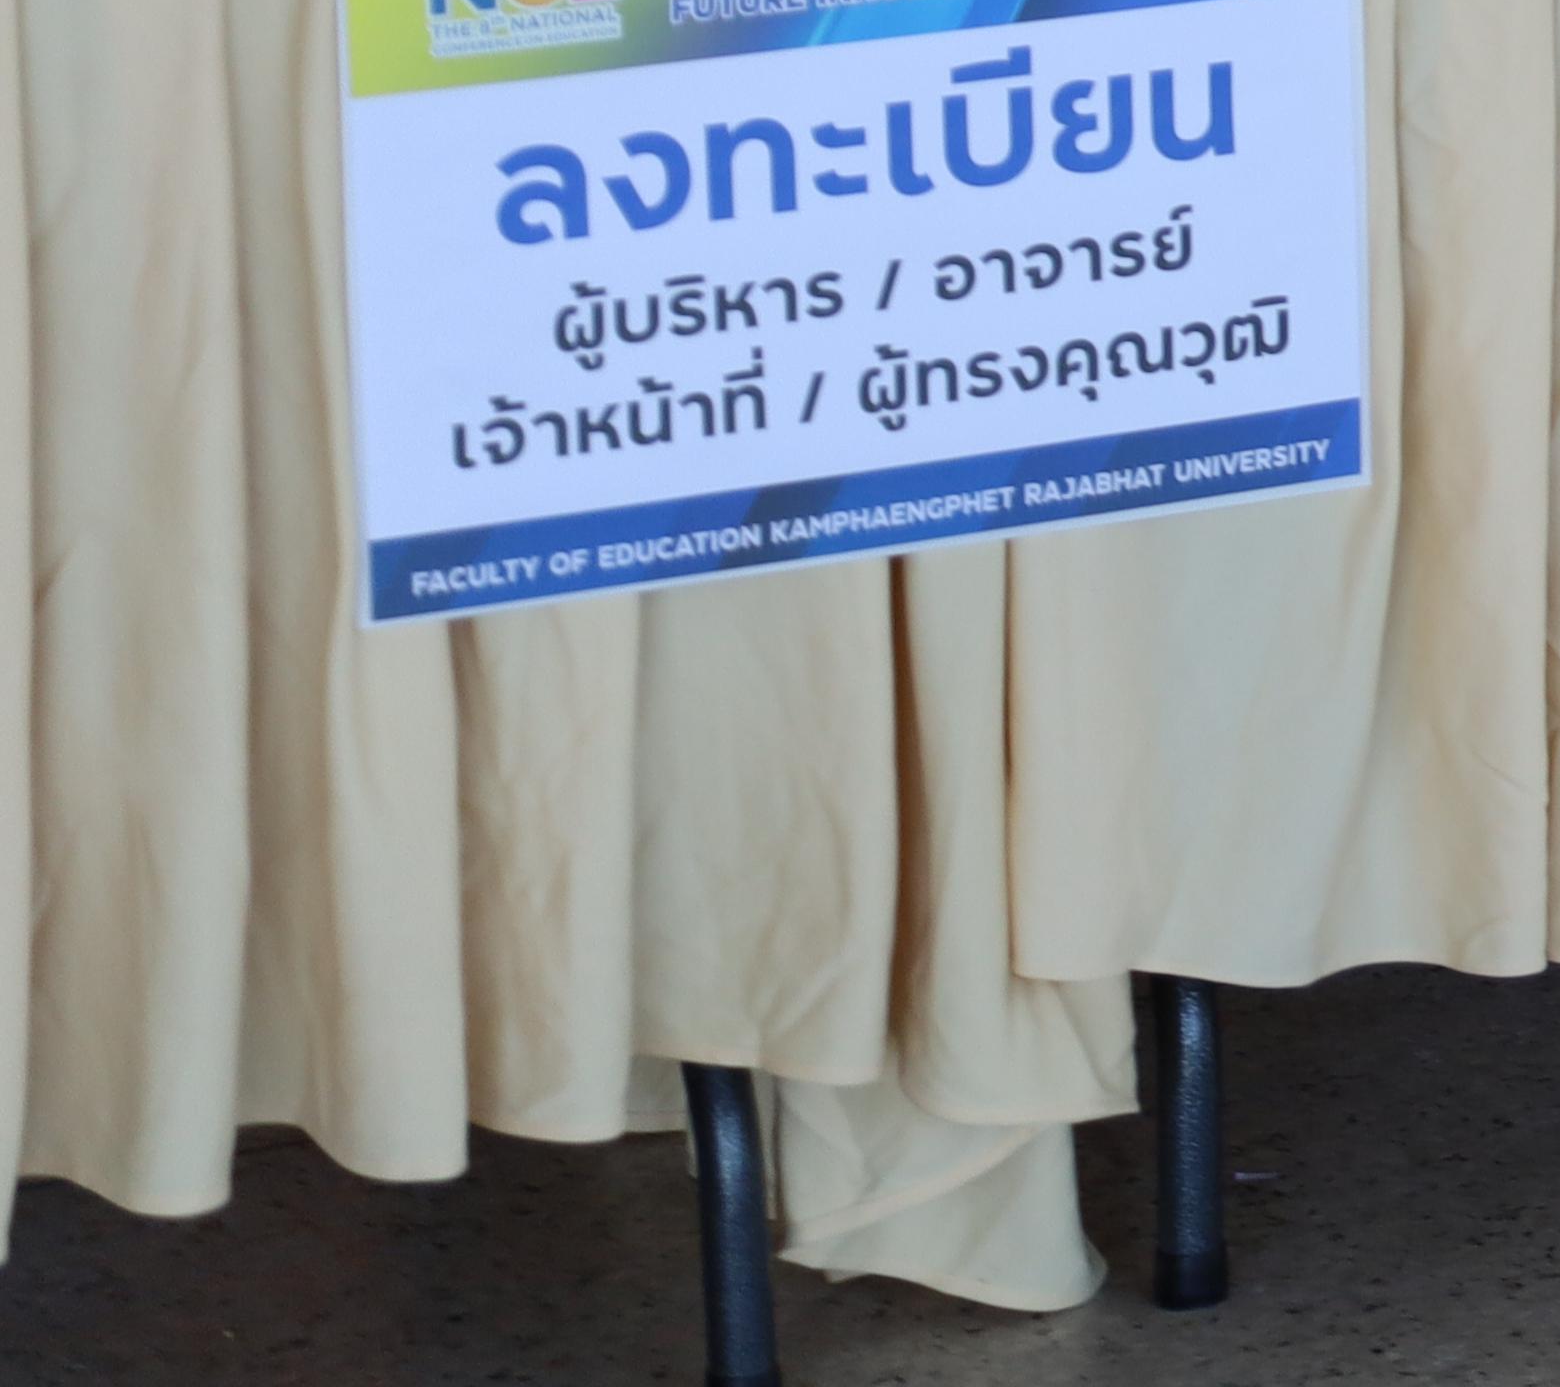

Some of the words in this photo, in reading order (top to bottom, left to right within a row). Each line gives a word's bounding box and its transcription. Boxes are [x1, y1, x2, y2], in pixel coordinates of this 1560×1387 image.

[511, 6, 617, 32] NATIONAL
[494, 46, 1238, 246] ลงทะเบียน
[554, 264, 844, 370] ผู้บริหาร
[876, 259, 904, 310] /
[933, 205, 1195, 304] อาจารย์
[453, 347, 770, 471] เจ้าหน้าที่
[800, 373, 825, 424] /
[858, 296, 1291, 432] ผู้ทรงคุณวุฒิ
[411, 553, 540, 598] FACULTY
[549, 547, 588, 575] OF
[597, 522, 762, 570] EDUCATION
[770, 486, 1016, 545] KAMPHAENGPHET
[1024, 462, 1165, 508] RAJABHAT
[1174, 438, 1331, 484] UNIVERSITY
